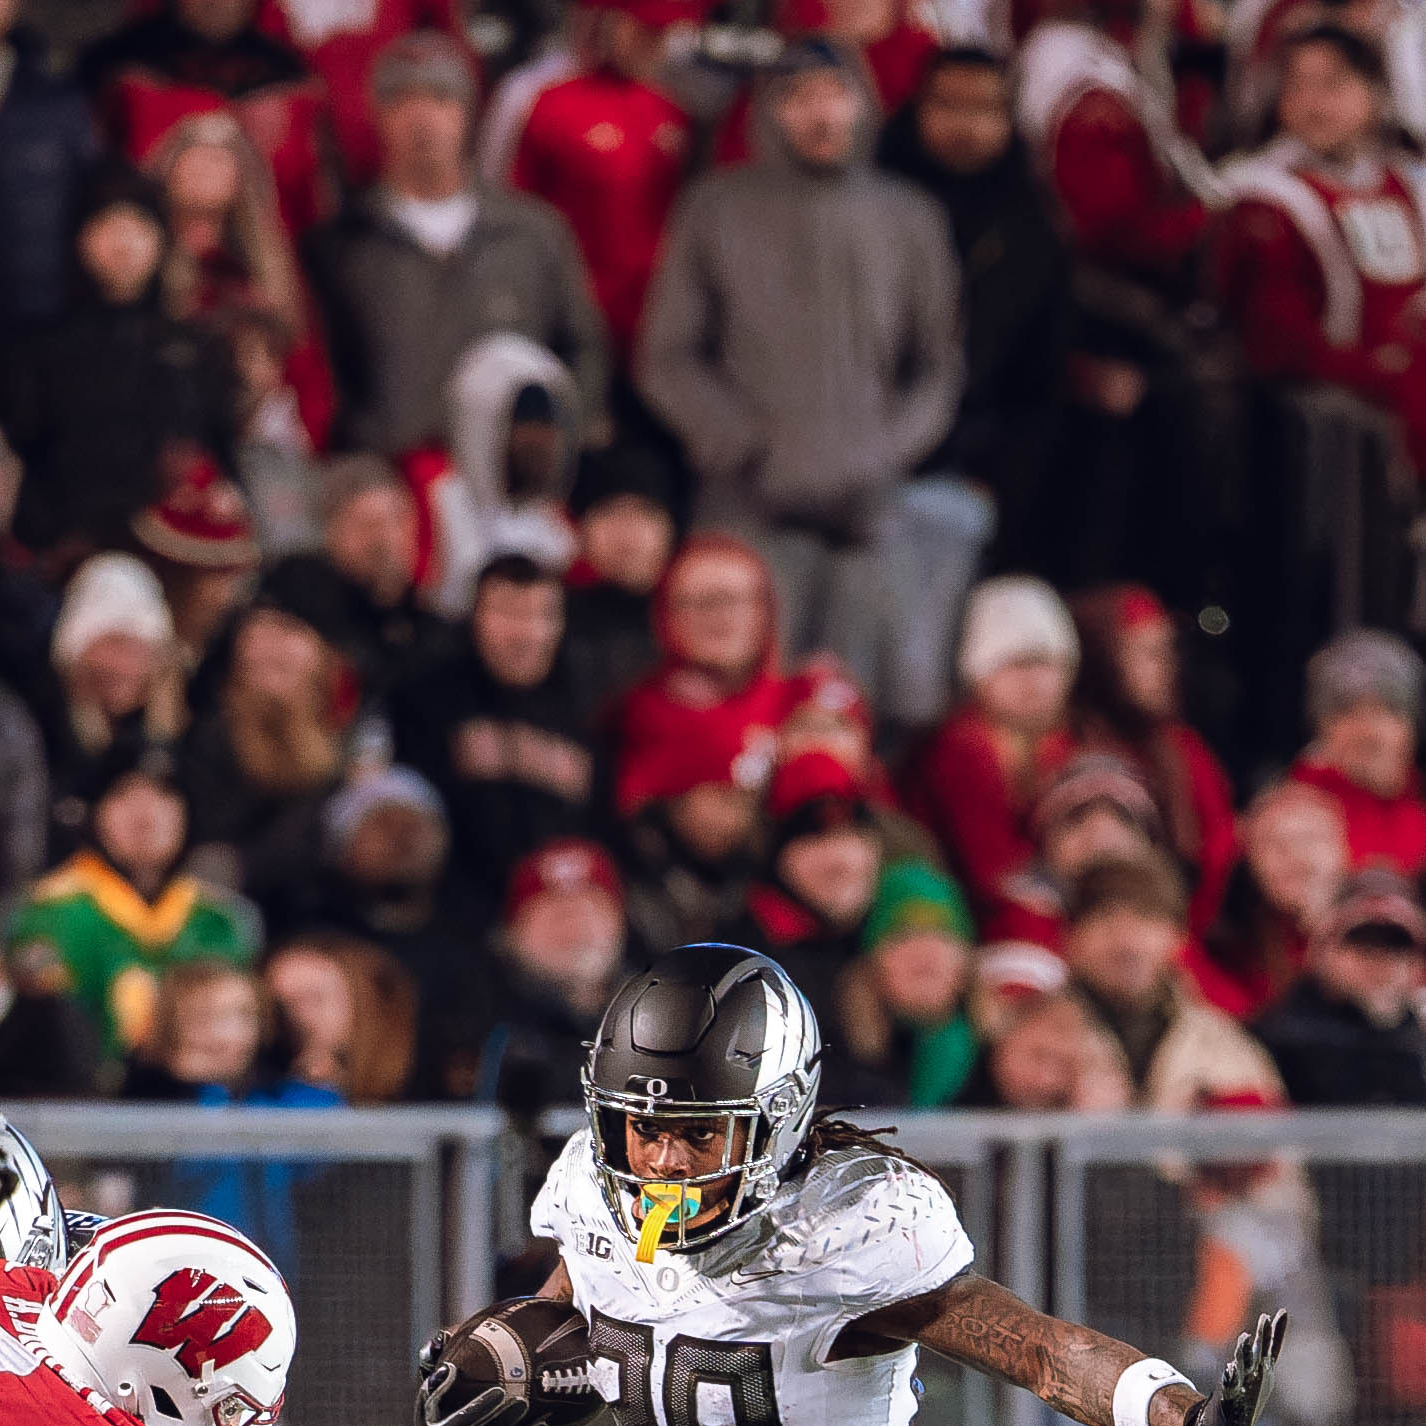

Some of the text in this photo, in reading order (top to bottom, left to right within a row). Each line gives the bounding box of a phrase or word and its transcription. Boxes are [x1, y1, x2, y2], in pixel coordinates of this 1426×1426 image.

[647, 1078, 668, 1097] O
[656, 1266, 680, 1293] O
[128, 1268, 273, 1378] W
